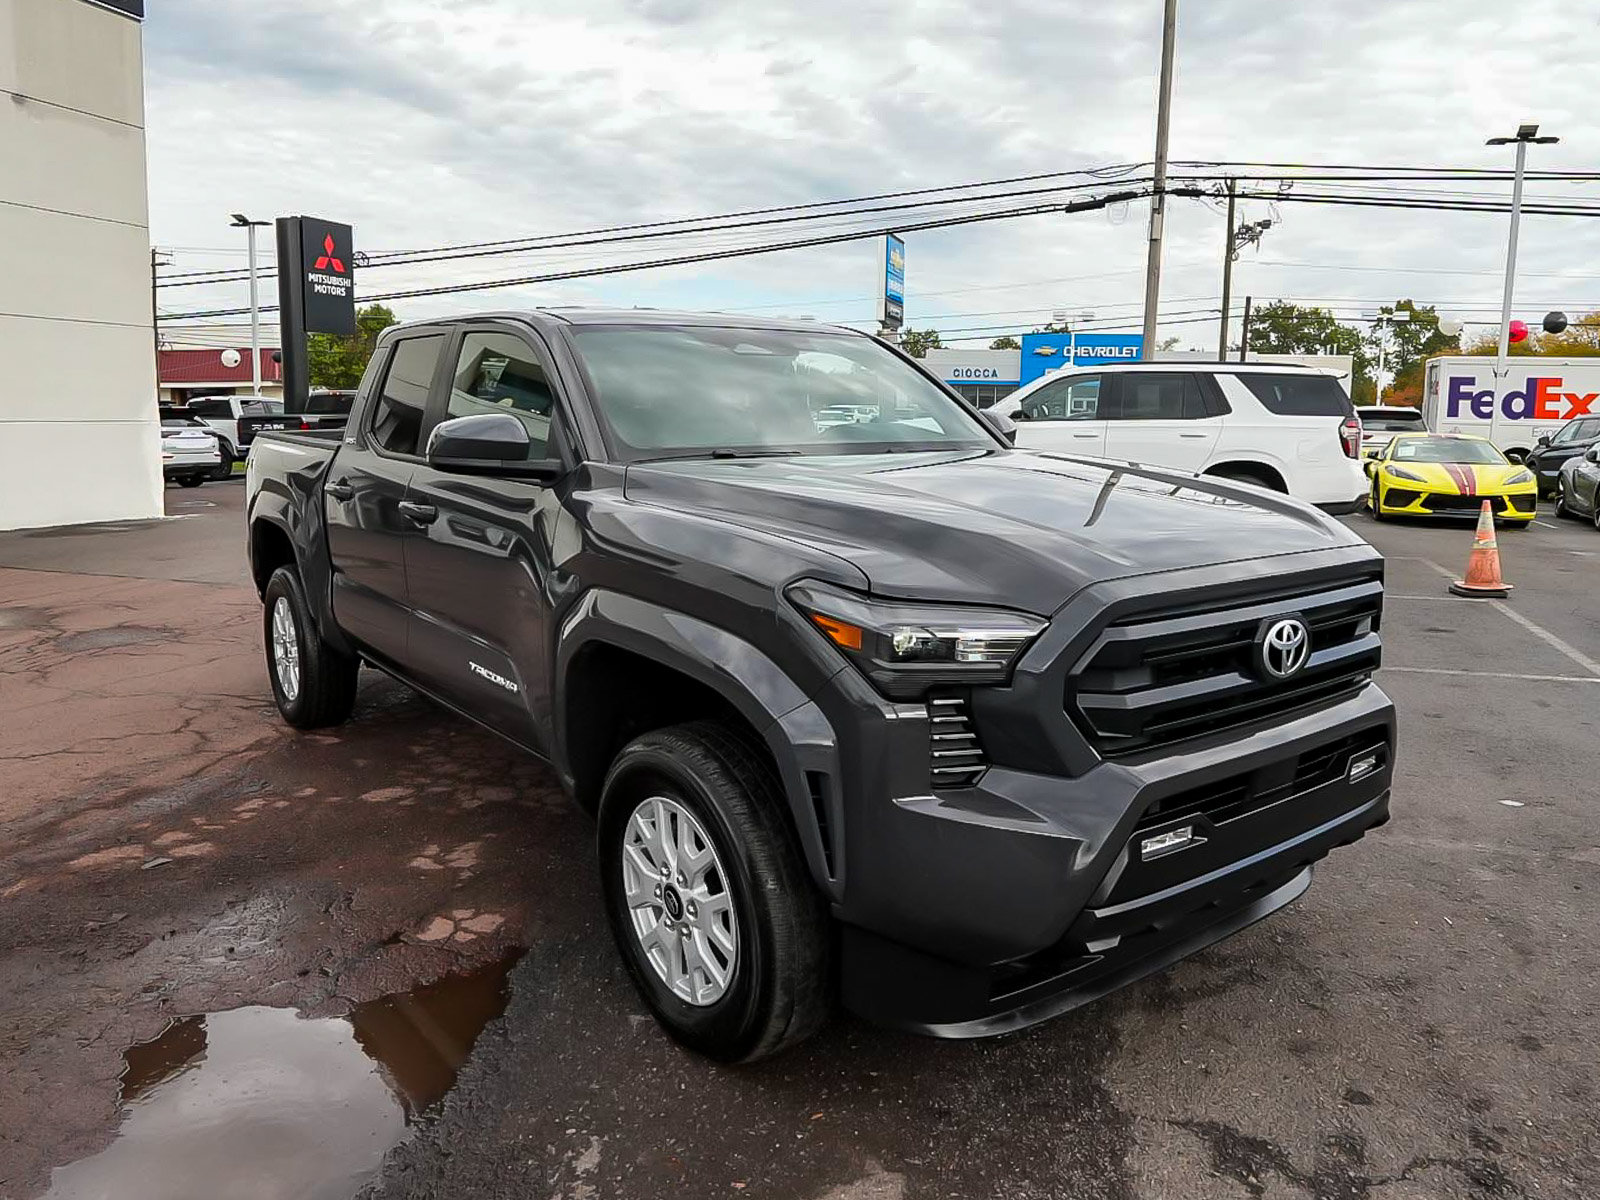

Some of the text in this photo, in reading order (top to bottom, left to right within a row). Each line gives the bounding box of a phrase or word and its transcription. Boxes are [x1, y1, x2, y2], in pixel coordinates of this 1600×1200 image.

[308, 272, 351, 287] MITSUBISHI
[314, 283, 346, 297] MOTORS
[1063, 346, 1140, 358] CHEVROLET
[953, 368, 998, 378] CIOCCA
[1446, 376, 1600, 421] FedEx
[251, 423, 285, 431] RAM
[468, 661, 518, 693] TACOMA
